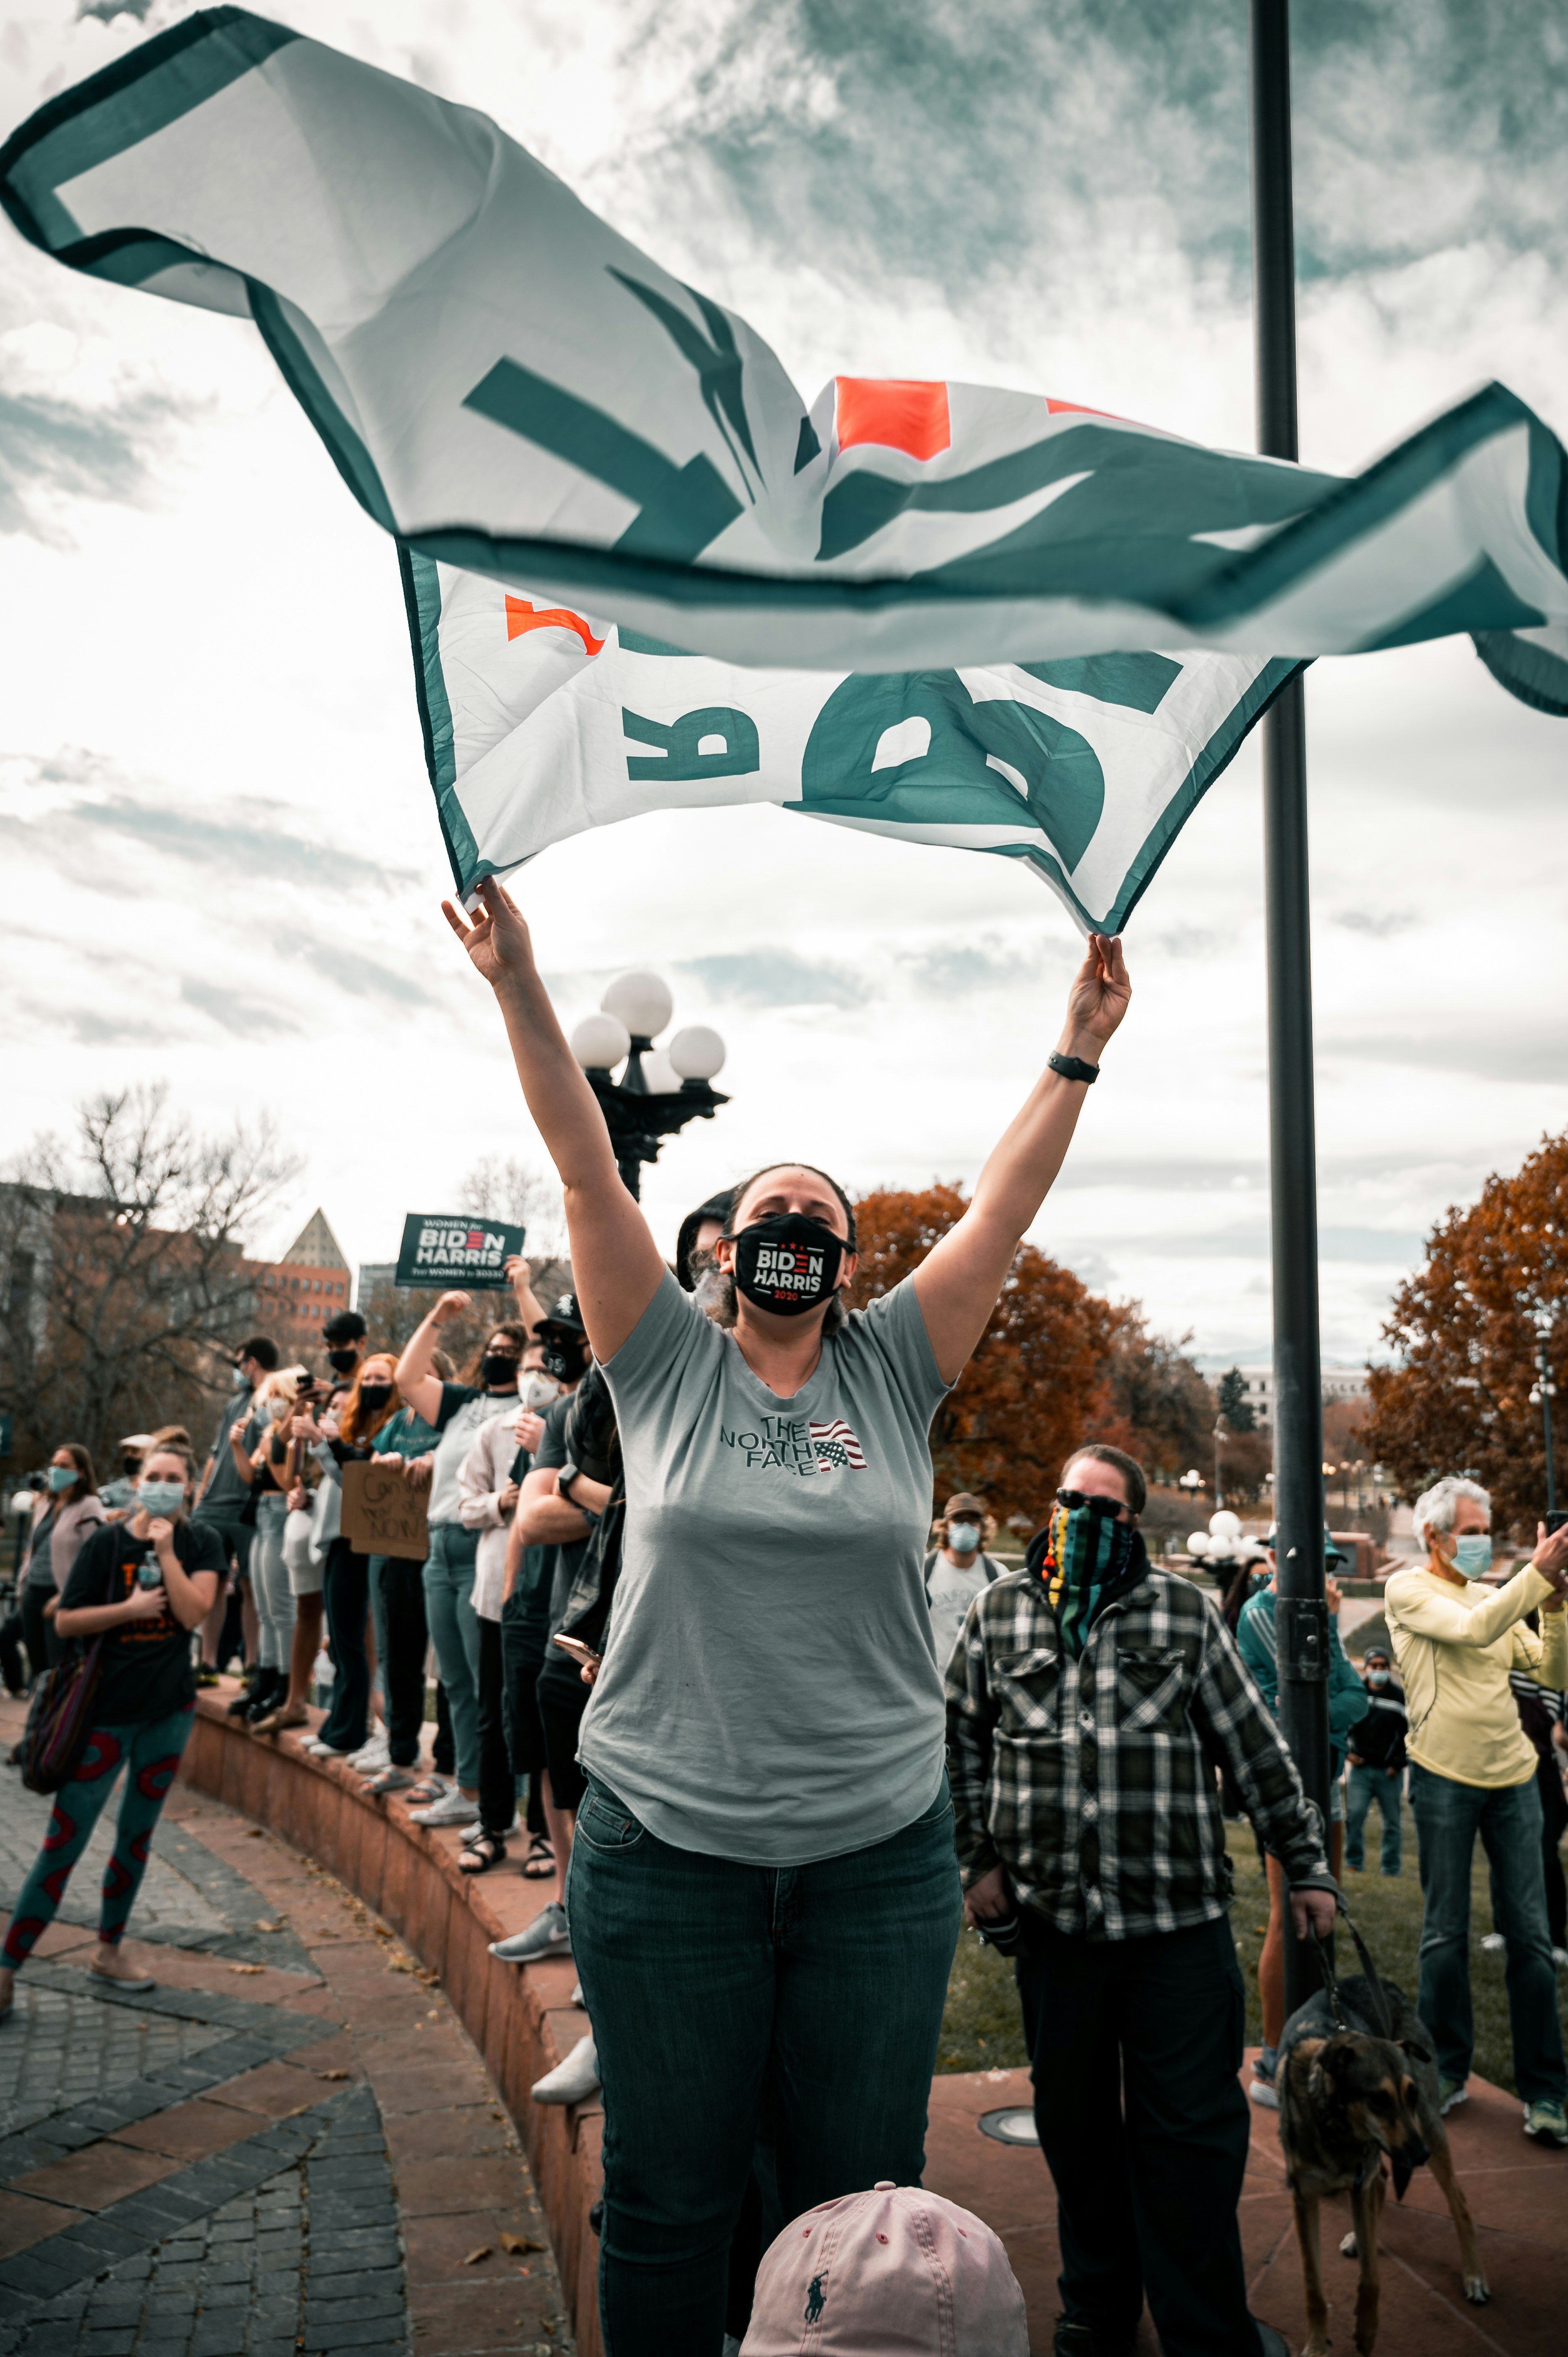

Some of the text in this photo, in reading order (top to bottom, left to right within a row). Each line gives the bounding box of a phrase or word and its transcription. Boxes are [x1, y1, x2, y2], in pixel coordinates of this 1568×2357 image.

[422, 1218, 468, 1229] WOMEN
[419, 1228, 505, 1250] BIDEN
[416, 1248, 502, 1267] HARRIS
[756, 1249, 823, 1276] BIDEN
[429, 1268, 466, 1278] WOMEN
[753, 1269, 821, 1292] HARRIS
[774, 1290, 798, 1301] 2020
[760, 1416, 808, 1442] THE
